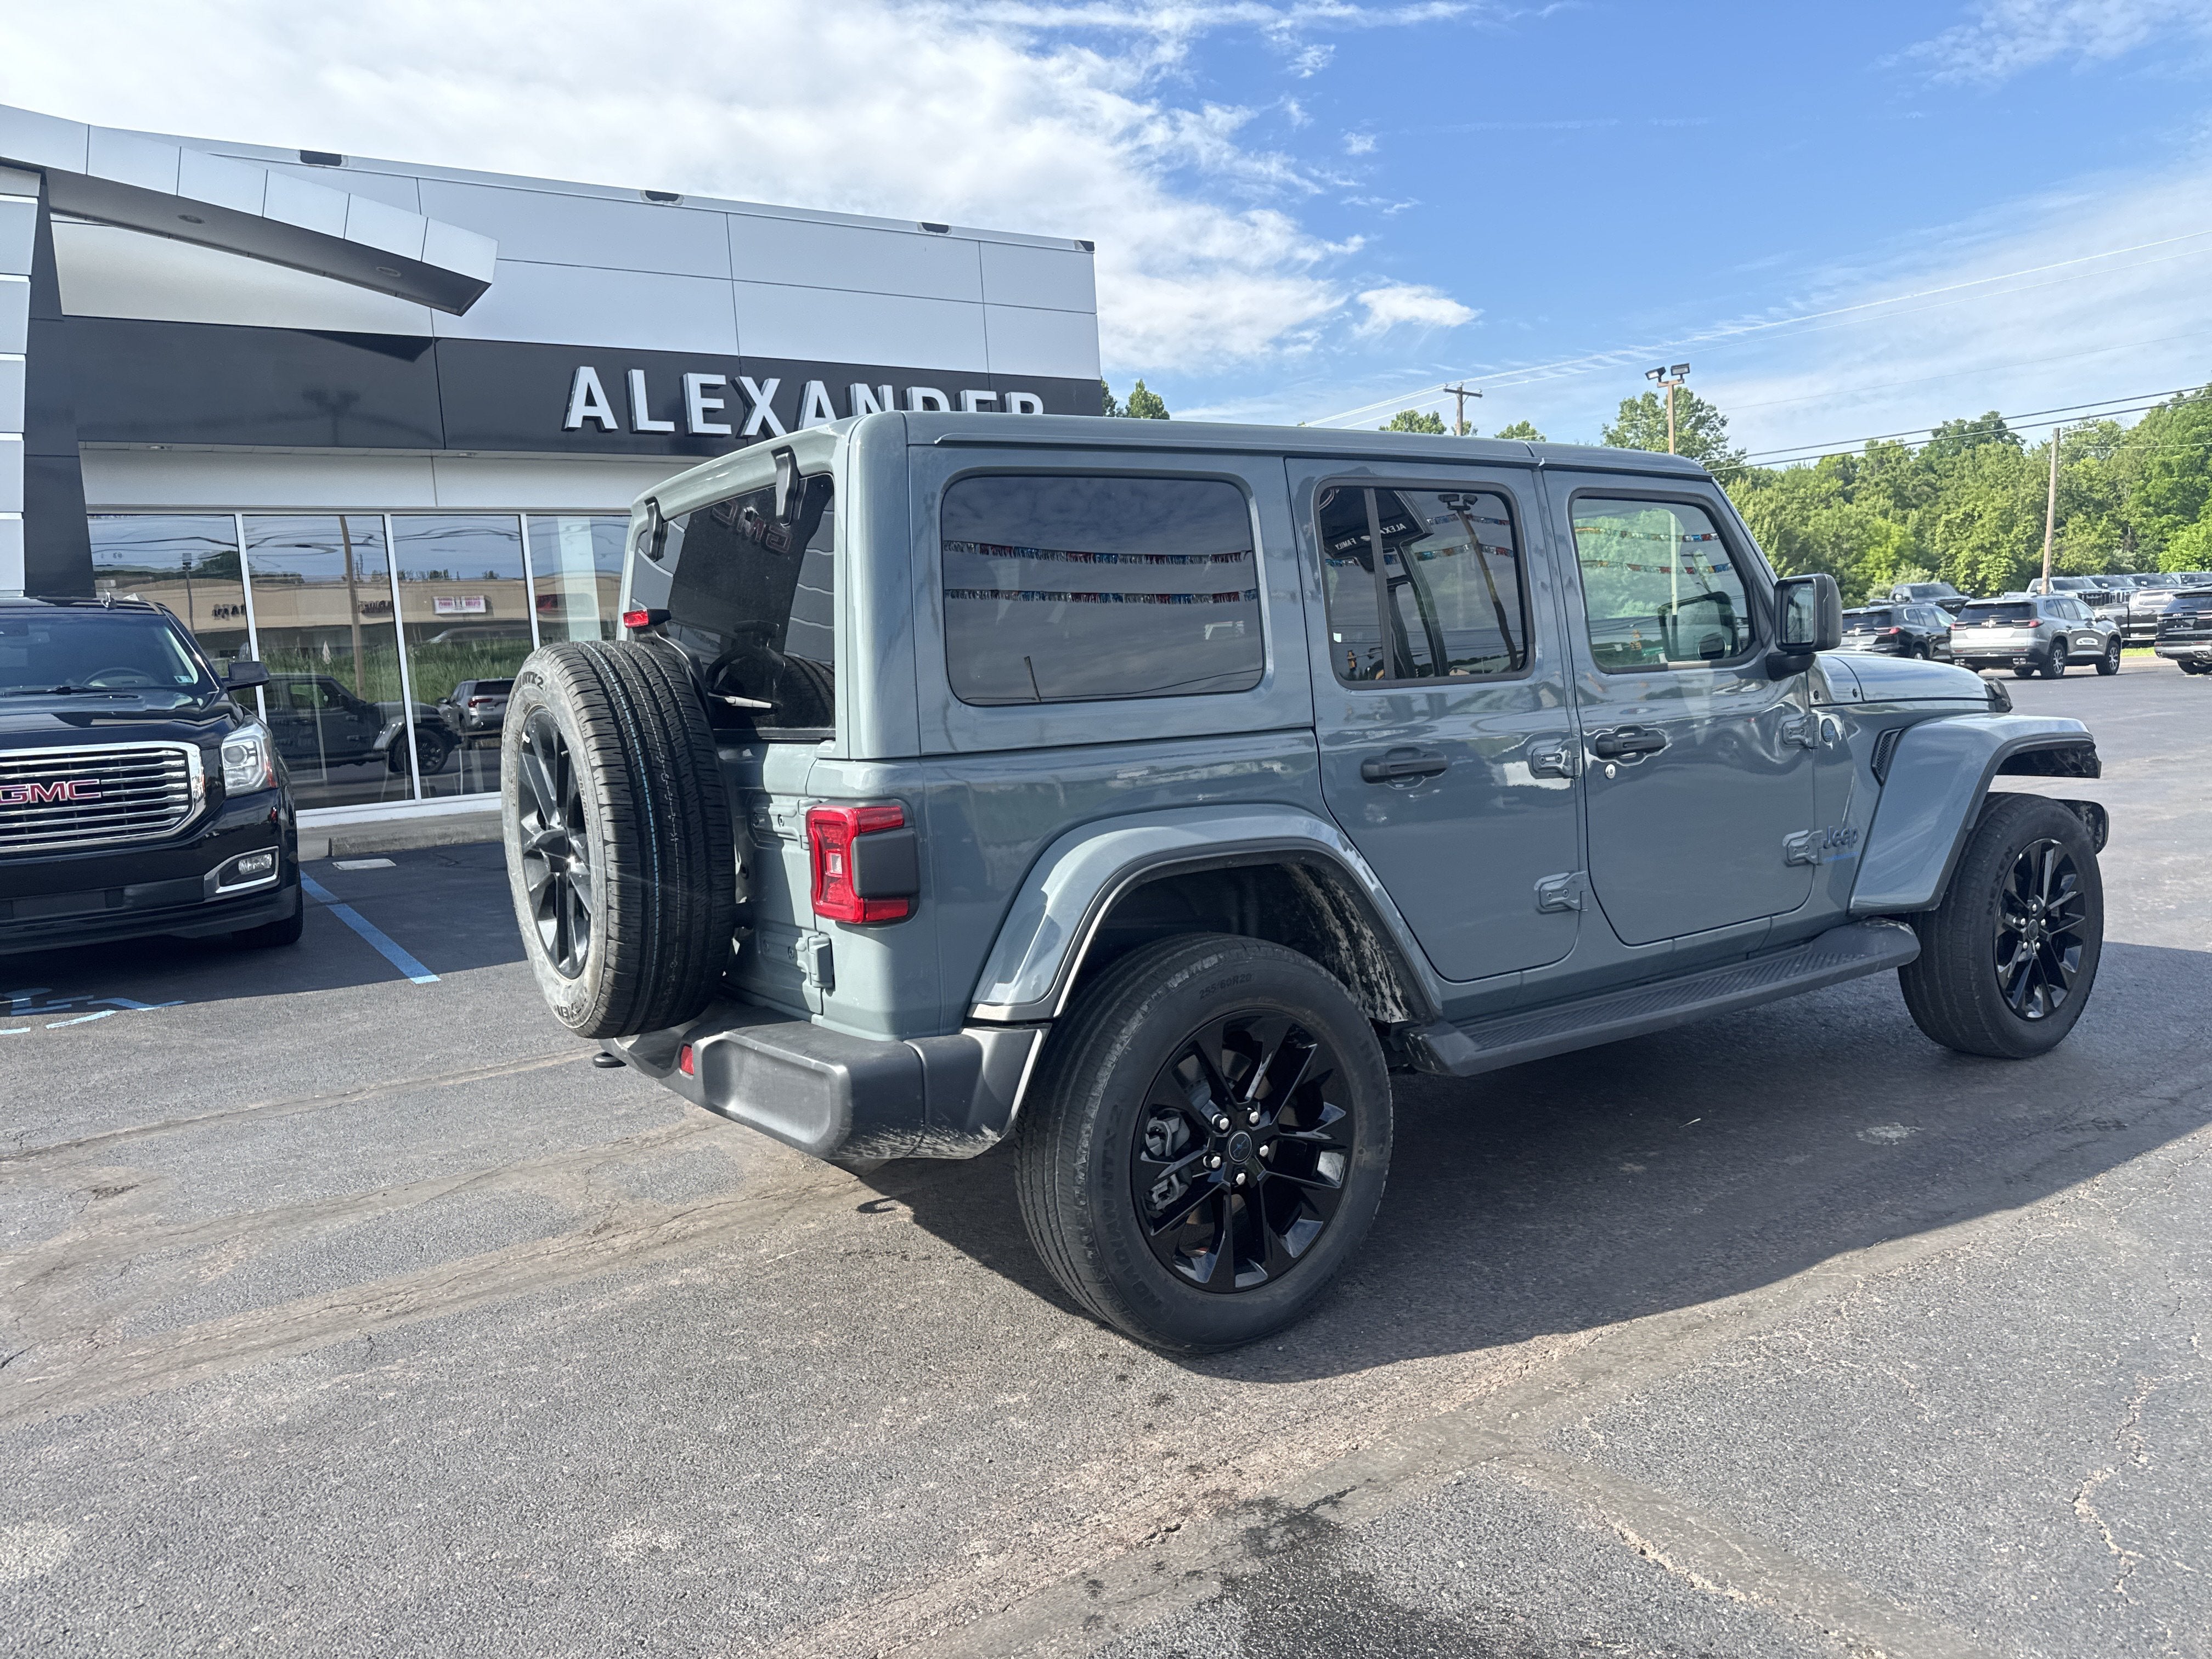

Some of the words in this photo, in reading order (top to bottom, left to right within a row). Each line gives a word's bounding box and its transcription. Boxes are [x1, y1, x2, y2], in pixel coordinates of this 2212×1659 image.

[0, 778, 102, 805] GMC
[1822, 826, 1859, 849] Jeep
[1987, 845, 2013, 915] NEXEN
[1199, 972, 1254, 1000] 255/60R20
